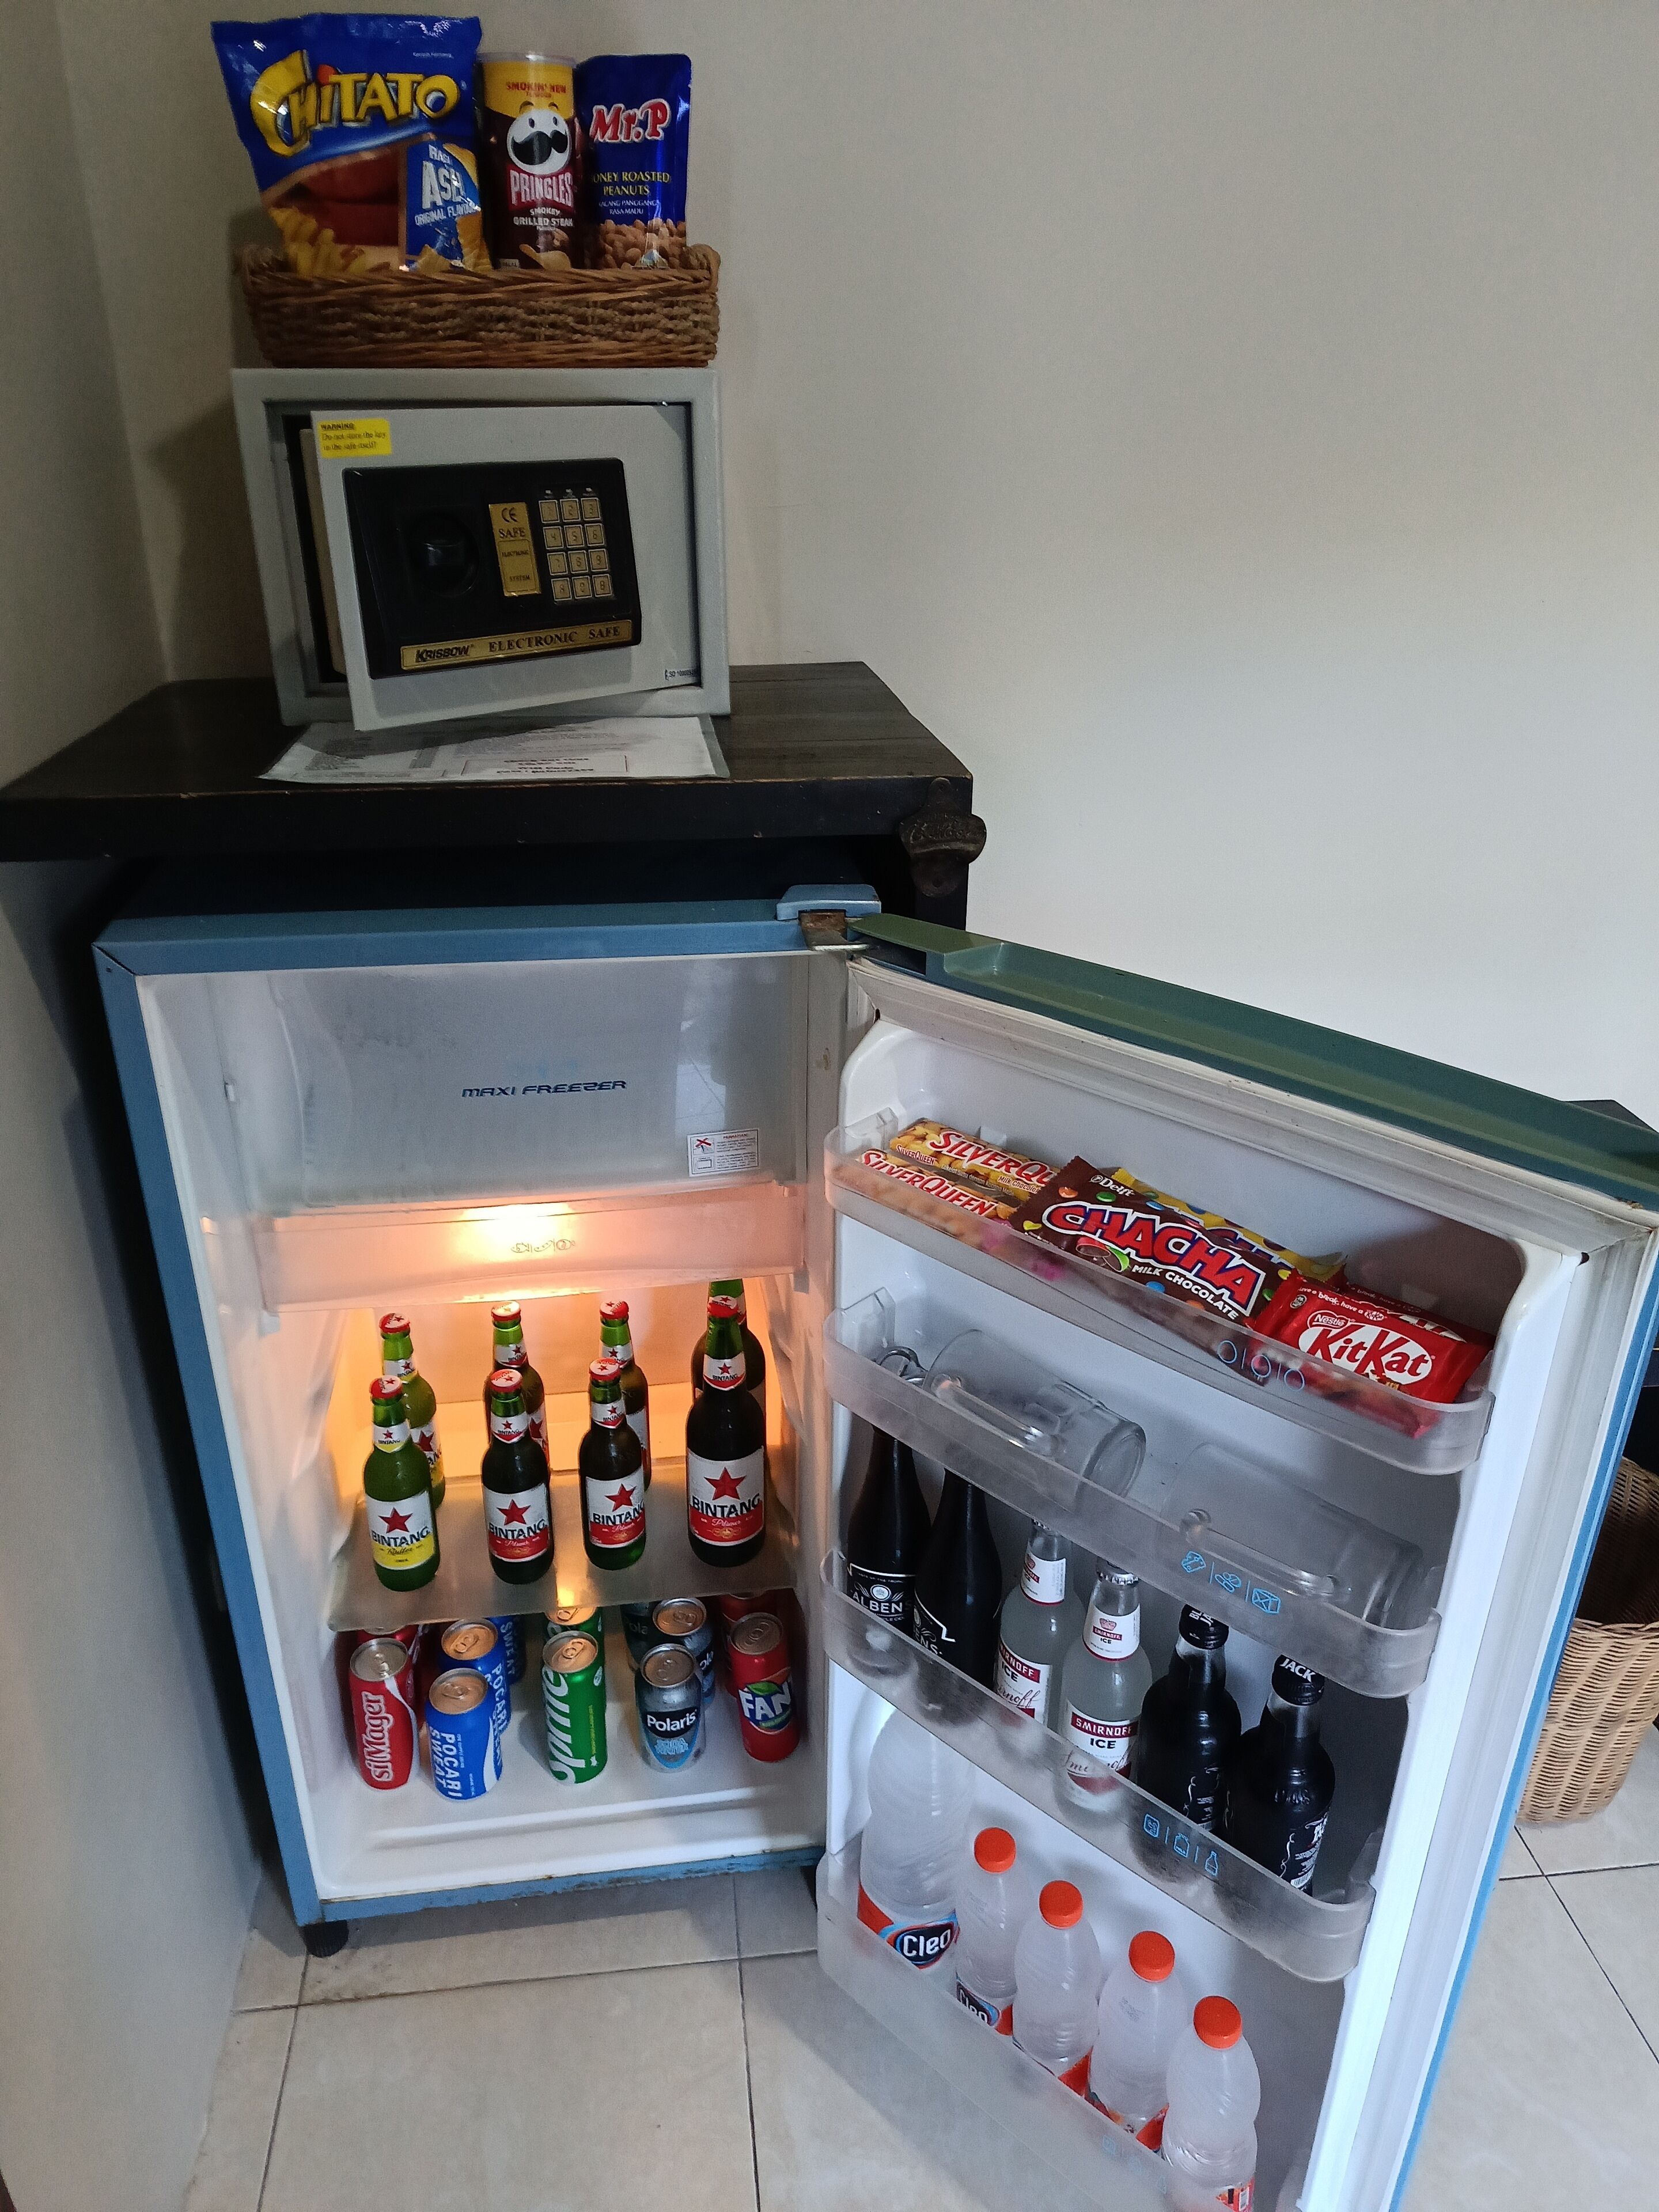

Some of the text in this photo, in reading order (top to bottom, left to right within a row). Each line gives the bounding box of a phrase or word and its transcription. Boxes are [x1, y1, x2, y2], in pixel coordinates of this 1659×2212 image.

[510, 169, 574, 207] PRINGLES
[622, 171, 671, 183] ROASTED
[603, 184, 651, 196] PEANUTS
[414, 209, 446, 226] ORIGINAL
[513, 216, 550, 226] GRILLED
[498, 527, 527, 539] SAFE
[489, 631, 578, 652] ELECTRONIC
[588, 626, 621, 638] SAFE
[461, 1080, 627, 1097] MAXI FREEZER
[863, 1151, 997, 1215] SILVERQUEEN
[998, 1176, 1012, 1185] Milk
[1099, 1177, 1133, 1196] Delfi
[1044, 1203, 1263, 1311] CHACHA
[1131, 1264, 1240, 1320] MILK CHOCOLATE
[1340, 1301, 1358, 1312] have
[1306, 1324, 1429, 1377] KitKat
[692, 1493, 760, 1518] BINTANG
[371, 1526, 431, 1547] BINTANG
[488, 1518, 548, 1540] BINTANG
[853, 1591, 904, 1613] ALBEN
[1002, 1661, 1018, 1682] ICE
[1280, 1658, 1316, 1683] JACK
[492, 1663, 509, 1732] POCARI
[738, 1677, 793, 1720] FAN
[647, 1711, 696, 1732] Polaris
[1075, 1717, 1132, 1736] SMIRNOFF
[1090, 1738, 1116, 1749] ICE
[430, 1727, 447, 1788] SWEAT
[441, 1732, 463, 1797] POCARI
[903, 1929, 951, 1957] Cleo
